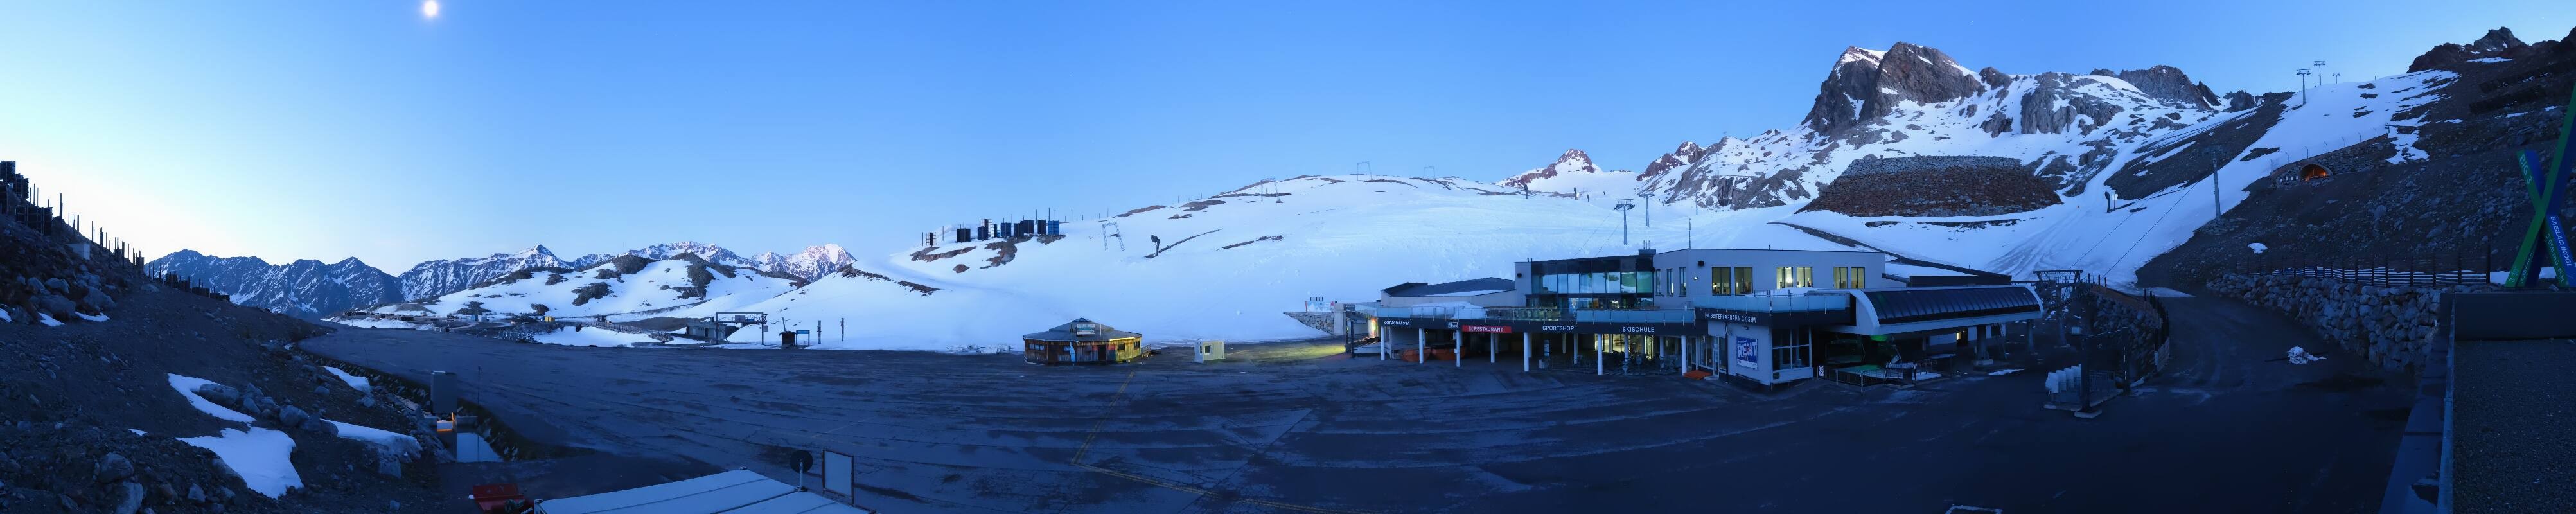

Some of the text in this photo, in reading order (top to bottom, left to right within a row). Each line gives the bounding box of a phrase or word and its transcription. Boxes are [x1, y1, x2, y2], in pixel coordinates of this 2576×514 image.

[2519, 154, 2534, 184] BIG 3
[2550, 216, 2572, 268] GAISLACHKOGL
[1710, 313, 1741, 321] SEITERKARBAHN
[1737, 342, 1758, 358] RENT
